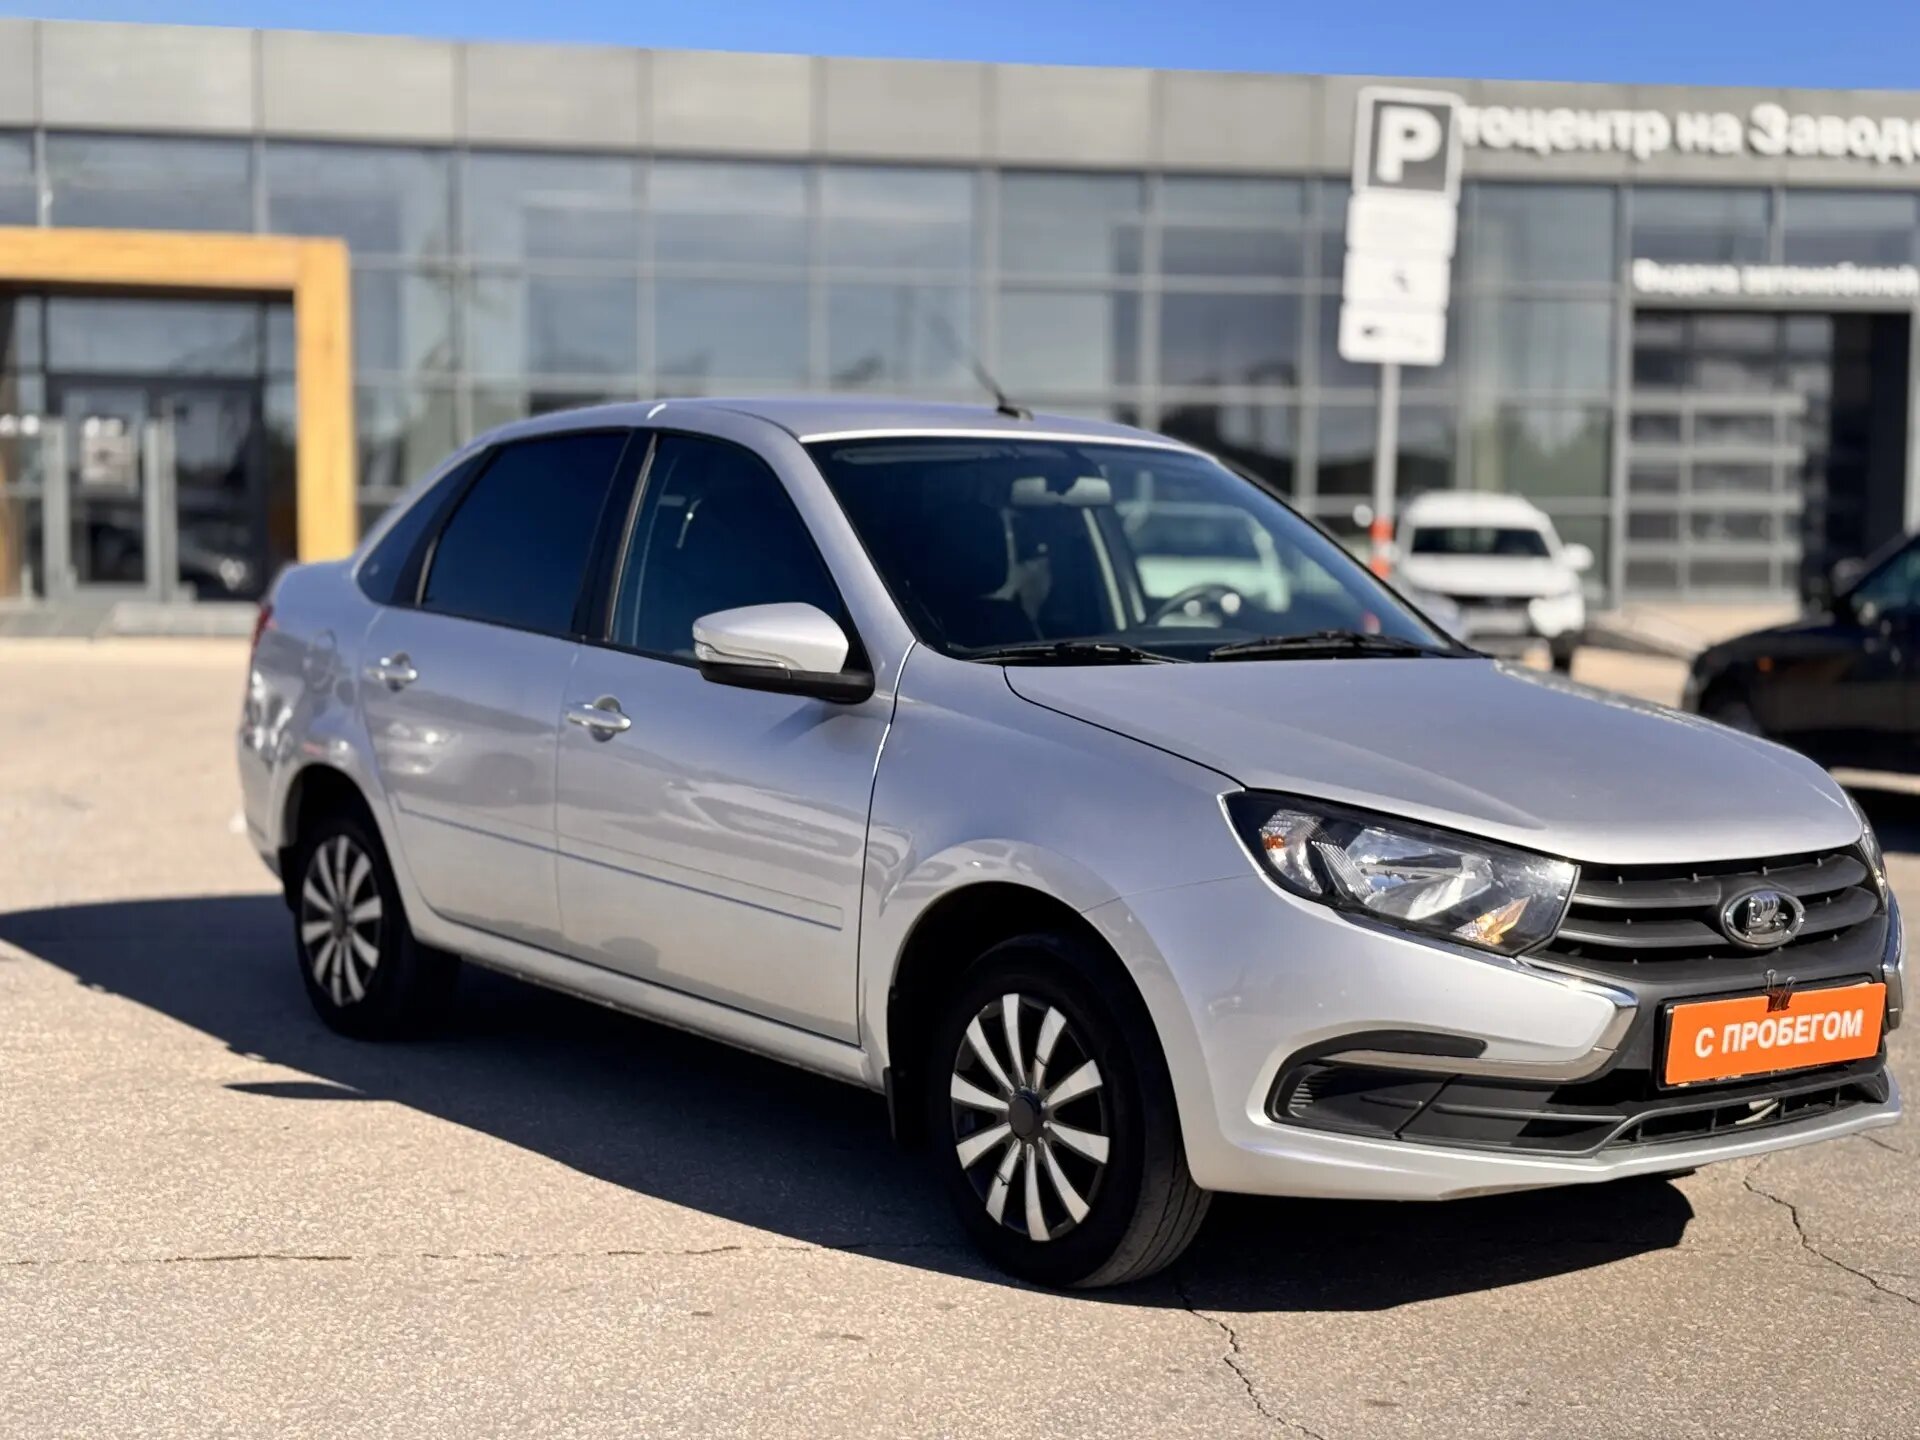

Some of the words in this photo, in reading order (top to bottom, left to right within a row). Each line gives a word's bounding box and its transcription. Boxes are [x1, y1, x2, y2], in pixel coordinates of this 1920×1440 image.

[1376, 105, 1442, 183] P
[1676, 111, 1743, 153] на
[1694, 1027, 1715, 1058] С
[1721, 1008, 1864, 1054] ПРОБЕГОМ
